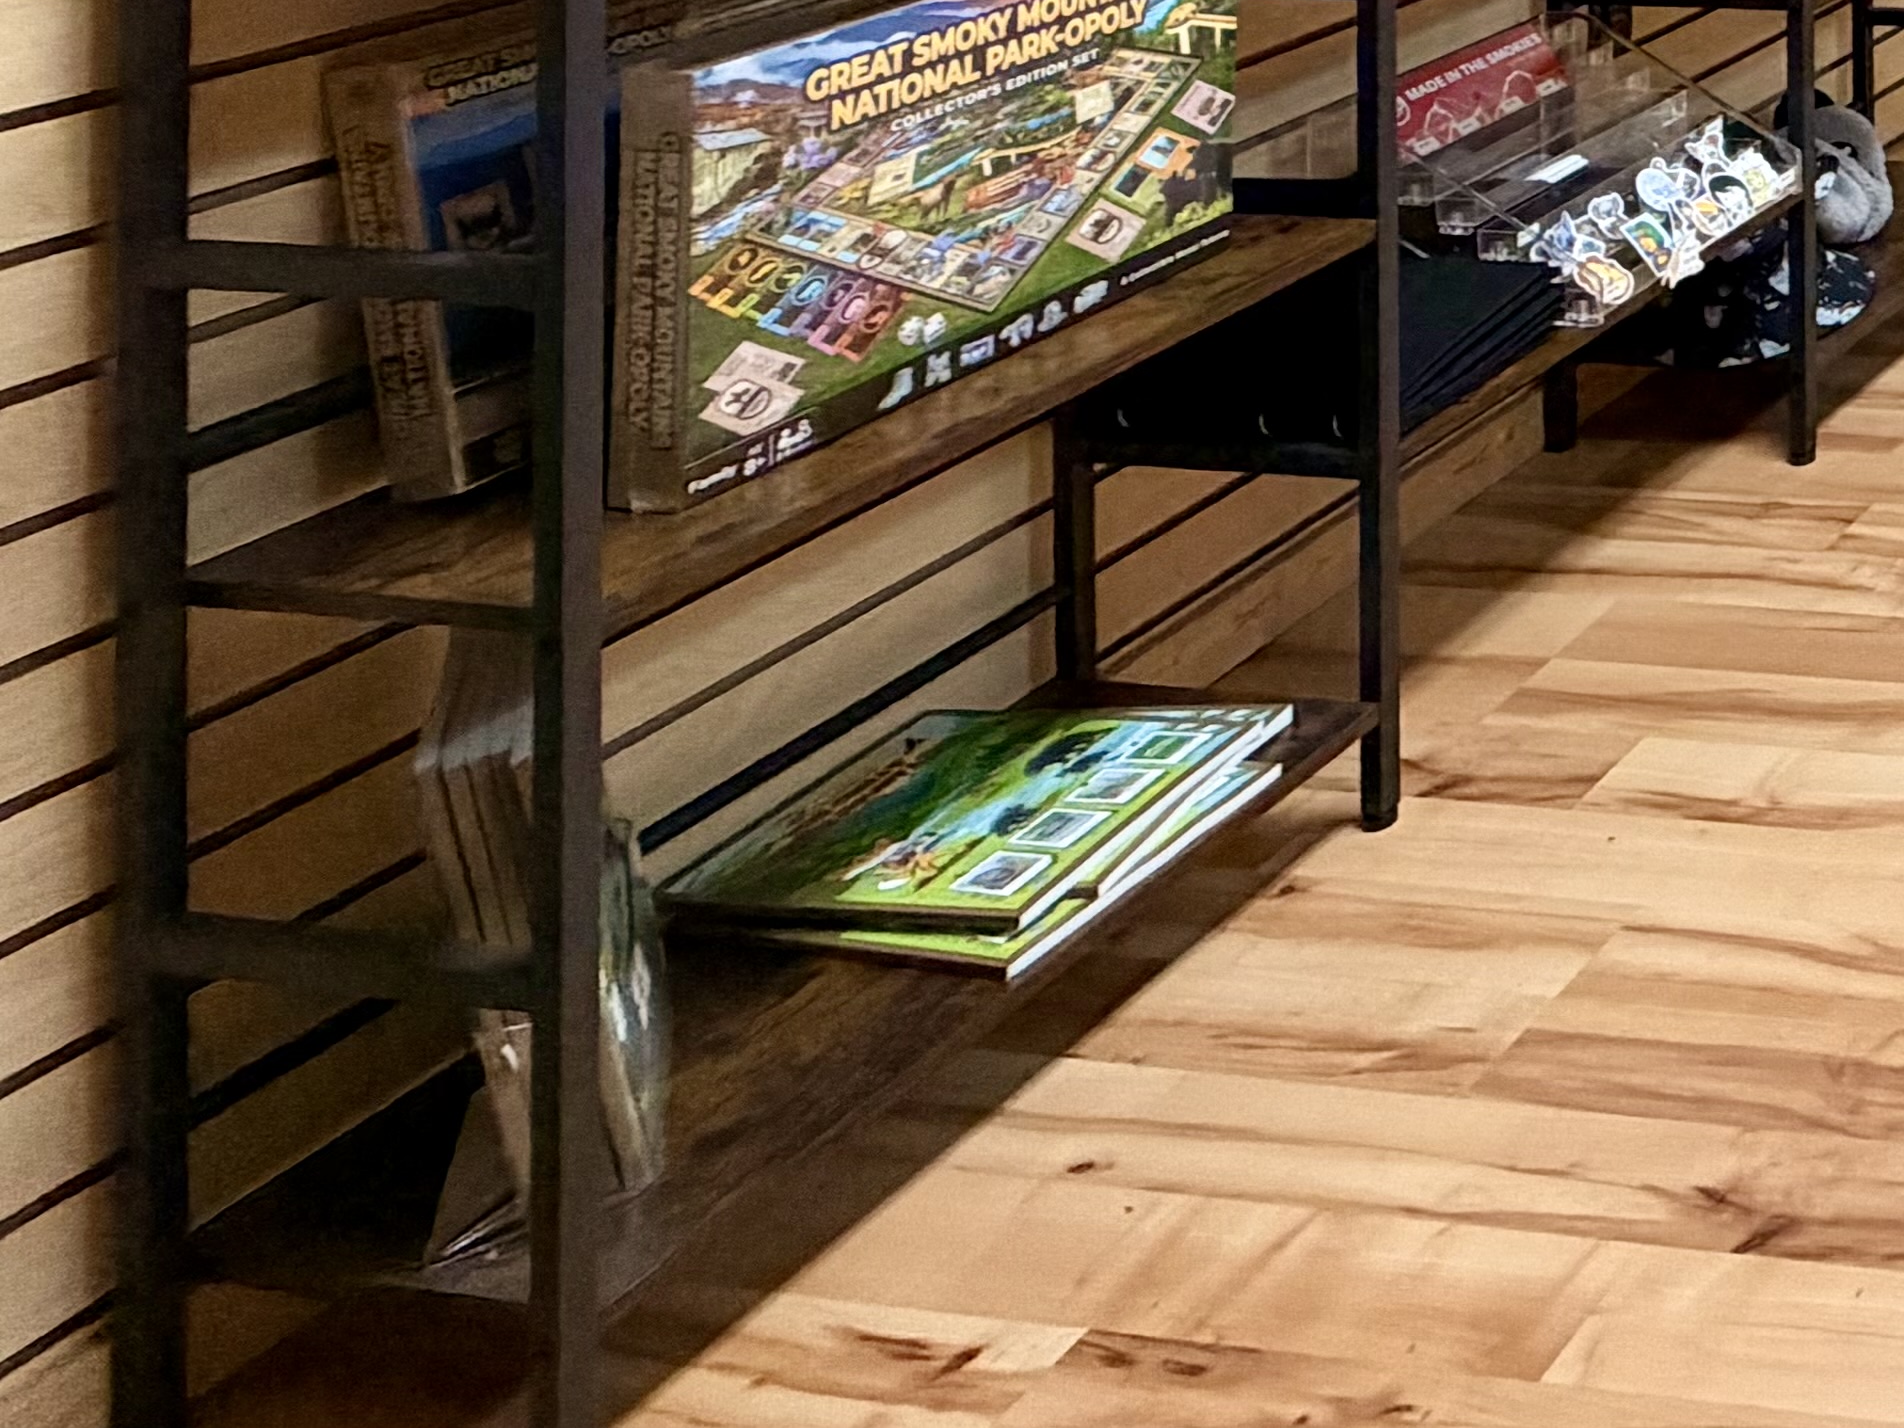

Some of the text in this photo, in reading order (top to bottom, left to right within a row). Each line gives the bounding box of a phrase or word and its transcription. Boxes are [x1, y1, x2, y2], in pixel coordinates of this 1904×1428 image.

[445, 63, 538, 106] NATIONA
[805, 44, 904, 102] GREAT
[912, 7, 1013, 67] SMOKY
[1404, 32, 1543, 101] MADE IN THE SMOKIES
[831, 61, 982, 131] NATIONAL
[890, 48, 1101, 133] COLLECTOR'S EDITION SET
